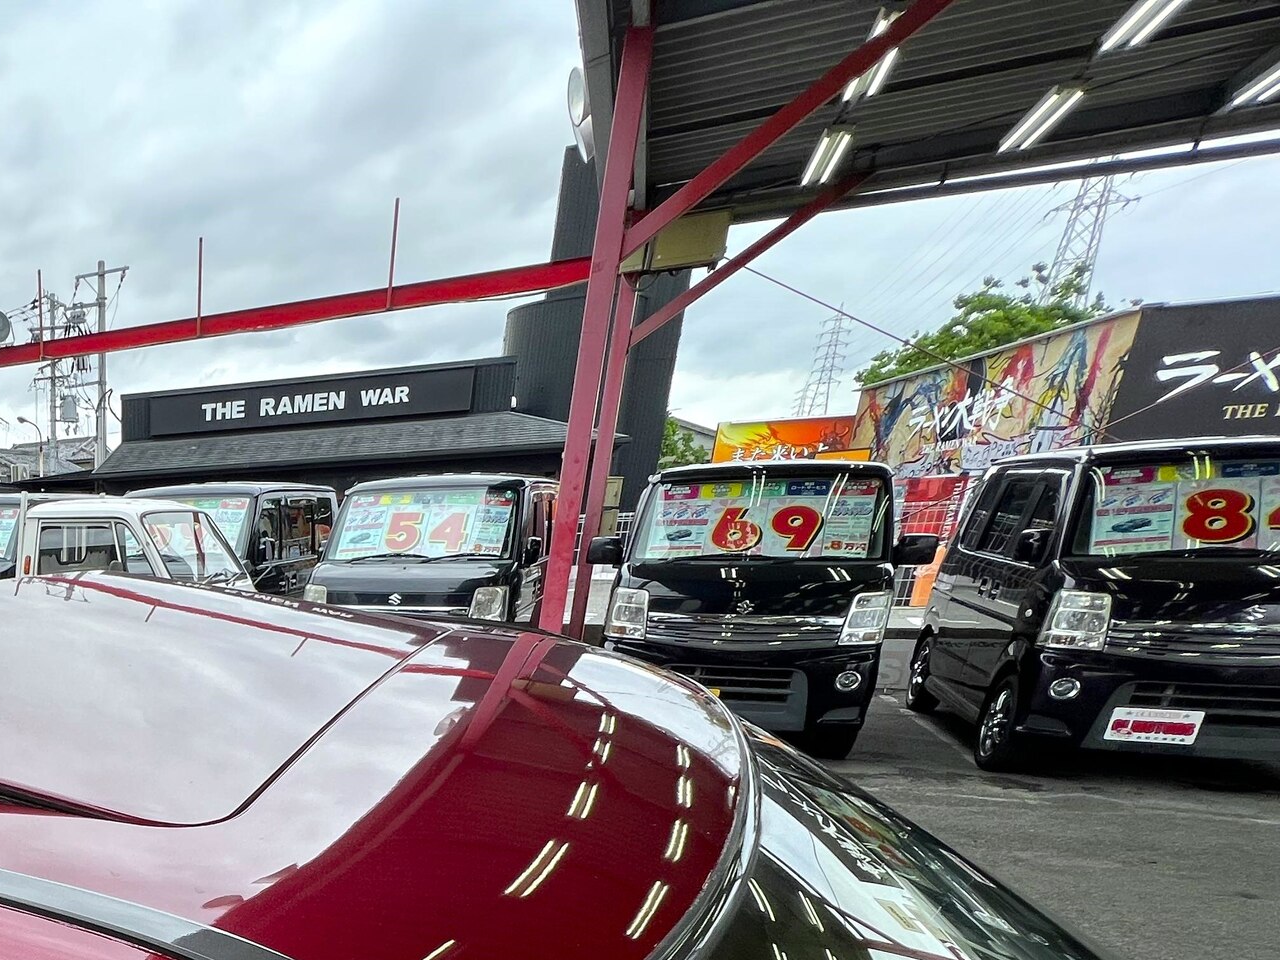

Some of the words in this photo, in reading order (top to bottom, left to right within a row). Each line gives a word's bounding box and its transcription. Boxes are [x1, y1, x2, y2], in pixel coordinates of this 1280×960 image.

[202, 400, 246, 421] THE
[259, 391, 346, 417] RAMEN
[360, 386, 410, 407] WAR
[1222, 403, 1269, 419] THE
[385, 512, 468, 552] 54
[711, 505, 824, 551] 69
[1182, 488, 1280, 544] 8
